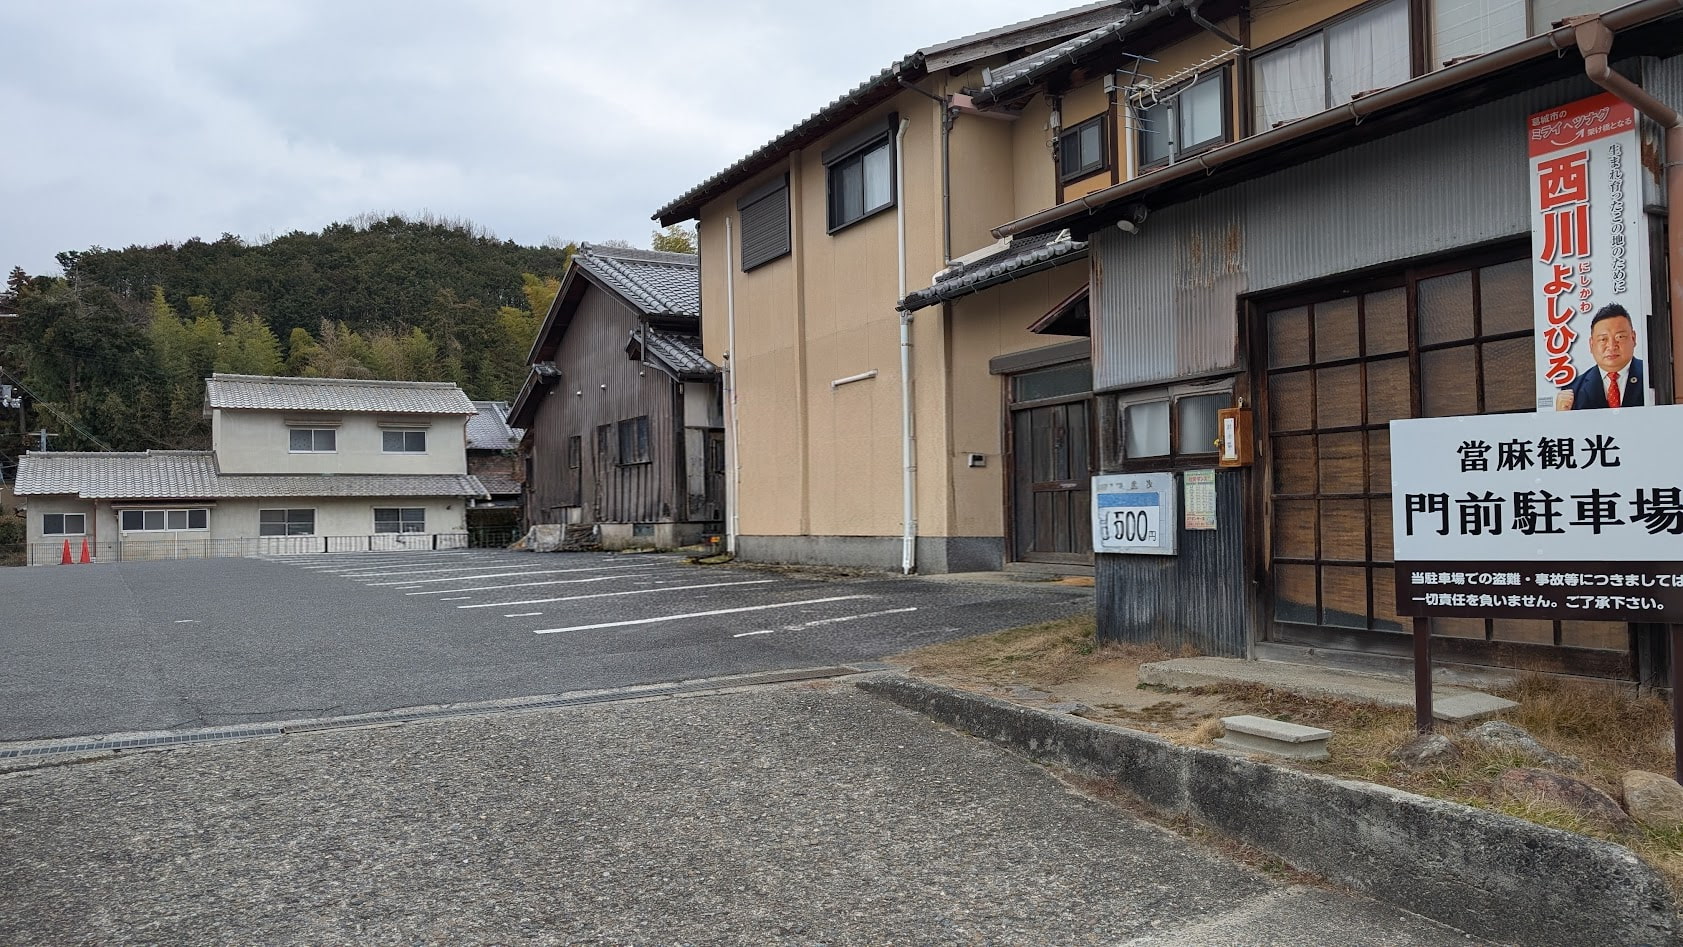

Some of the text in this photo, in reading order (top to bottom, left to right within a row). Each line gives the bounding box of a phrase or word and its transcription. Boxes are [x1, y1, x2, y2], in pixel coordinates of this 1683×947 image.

[1531, 110, 1567, 126] 葛城市の
[1531, 107, 1610, 140] ミライへツナグ
[1587, 117, 1632, 137] 架け橋となる
[1609, 144, 1624, 294] 生まれ育ったこの地のために
[1578, 262, 1592, 312] にしかわ
[1457, 434, 1621, 473] 當麻観光
[1405, 487, 1683, 536] 門前駐車場
